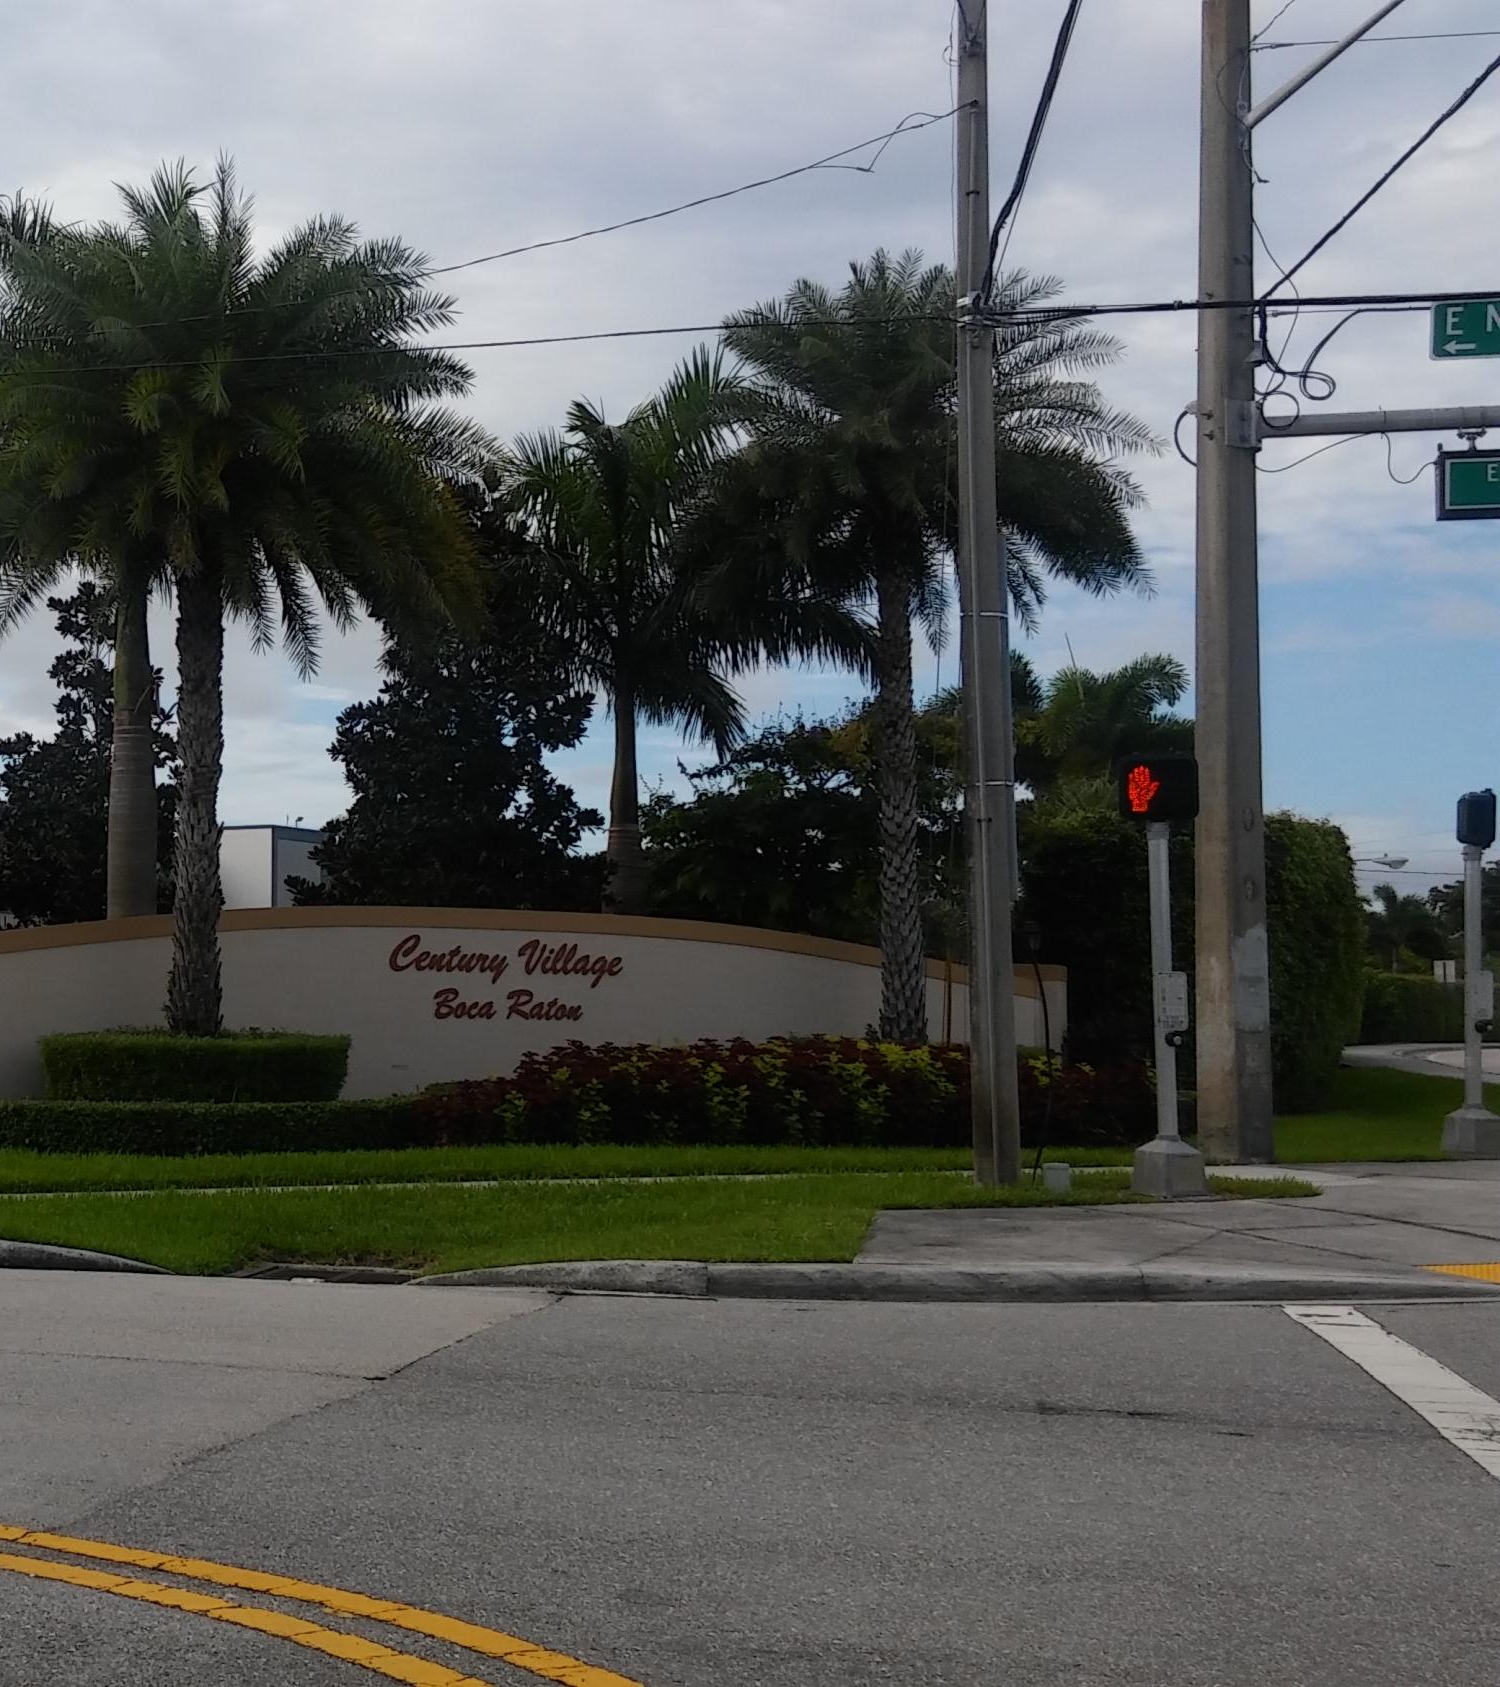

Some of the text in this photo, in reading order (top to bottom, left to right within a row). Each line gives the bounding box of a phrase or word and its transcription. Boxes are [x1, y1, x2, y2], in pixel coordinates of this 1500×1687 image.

[1445, 306, 1464, 335] E
[388, 934, 624, 988] Century Village
[433, 987, 583, 1021] Boca Raton
